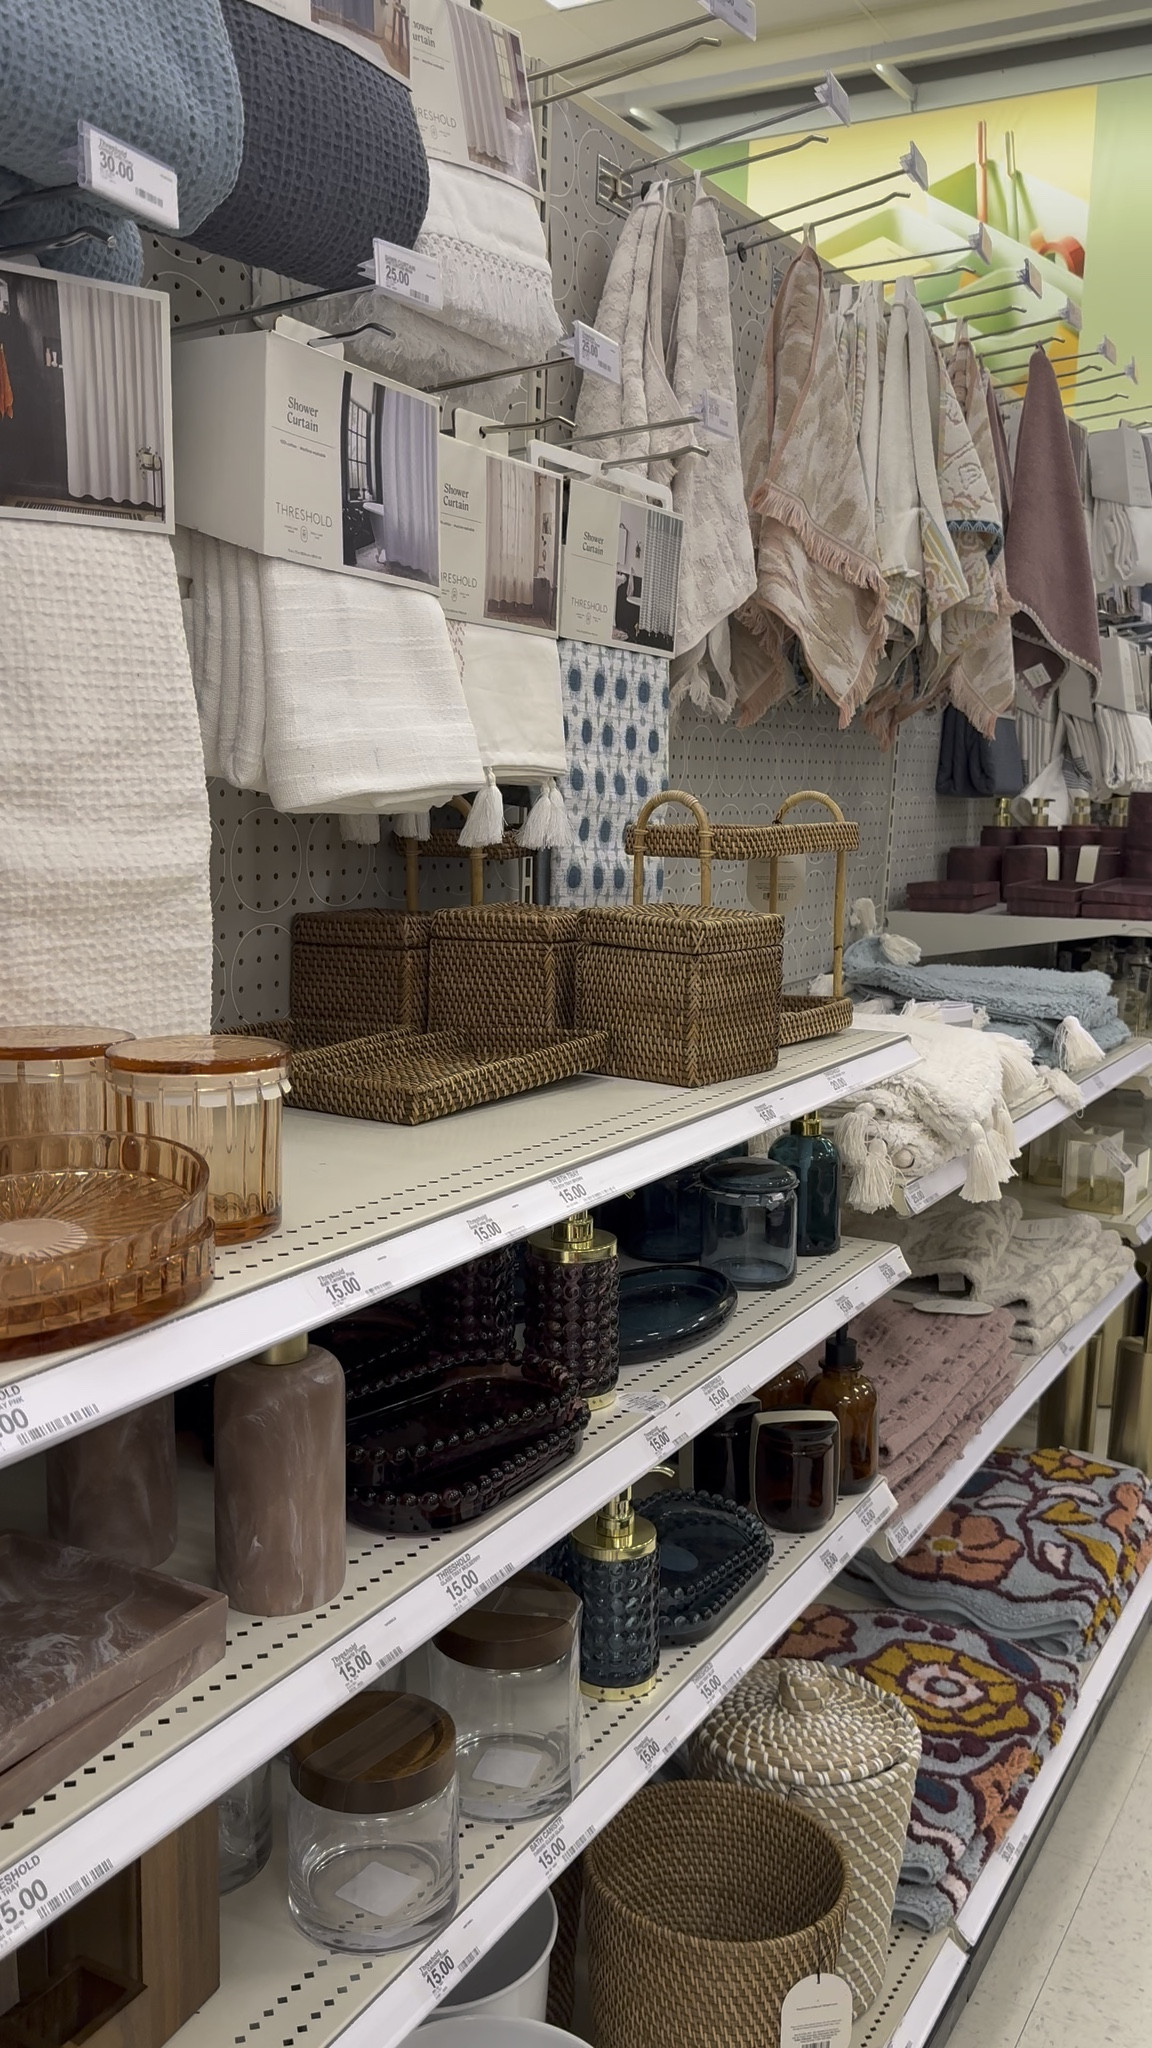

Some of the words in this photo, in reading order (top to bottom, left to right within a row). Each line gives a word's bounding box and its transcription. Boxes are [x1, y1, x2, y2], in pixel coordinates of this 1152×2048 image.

[100, 150, 134, 182] 30.00
[385, 265, 410, 286] 25.00
[287, 396, 319, 418] Shower
[287, 411, 319, 433] Curtain
[444, 482, 469, 499] Shower
[442, 496, 469, 511] Curtain
[276, 501, 333, 528] THRESHOLD
[582, 541, 604, 556] Curtain
[583, 531, 604, 546] Shower
[571, 597, 608, 614] THRESHOLD
[830, 1077, 847, 1090] 20.00
[760, 1108, 776, 1122] 15.00
[559, 1183, 587, 1203] 15.00
[474, 1221, 502, 1241] 15.00
[317, 1267, 346, 1282] Threshold
[326, 1276, 361, 1301] 15.00
[709, 1386, 730, 1407] 15.00
[649, 1431, 671, 1451] 15.00
[861, 1509, 875, 1527] 15.00
[436, 1553, 471, 1579] THRESHOLD
[824, 1553, 838, 1570] 15.00
[446, 1569, 479, 1600] 15.00
[331, 1642, 358, 1665] Threshold
[339, 1650, 373, 1681] 15.00
[700, 1674, 721, 1699] 15.00
[640, 1740, 660, 1764] 15.00
[530, 1835, 544, 1852] BATH
[542, 1816, 564, 1839] CANISTR
[538, 1837, 566, 1869] 15.00
[2, 1880, 20, 1897] TRAY
[419, 1949, 442, 1973] Threshold
[426, 1955, 455, 1988] 15.00
